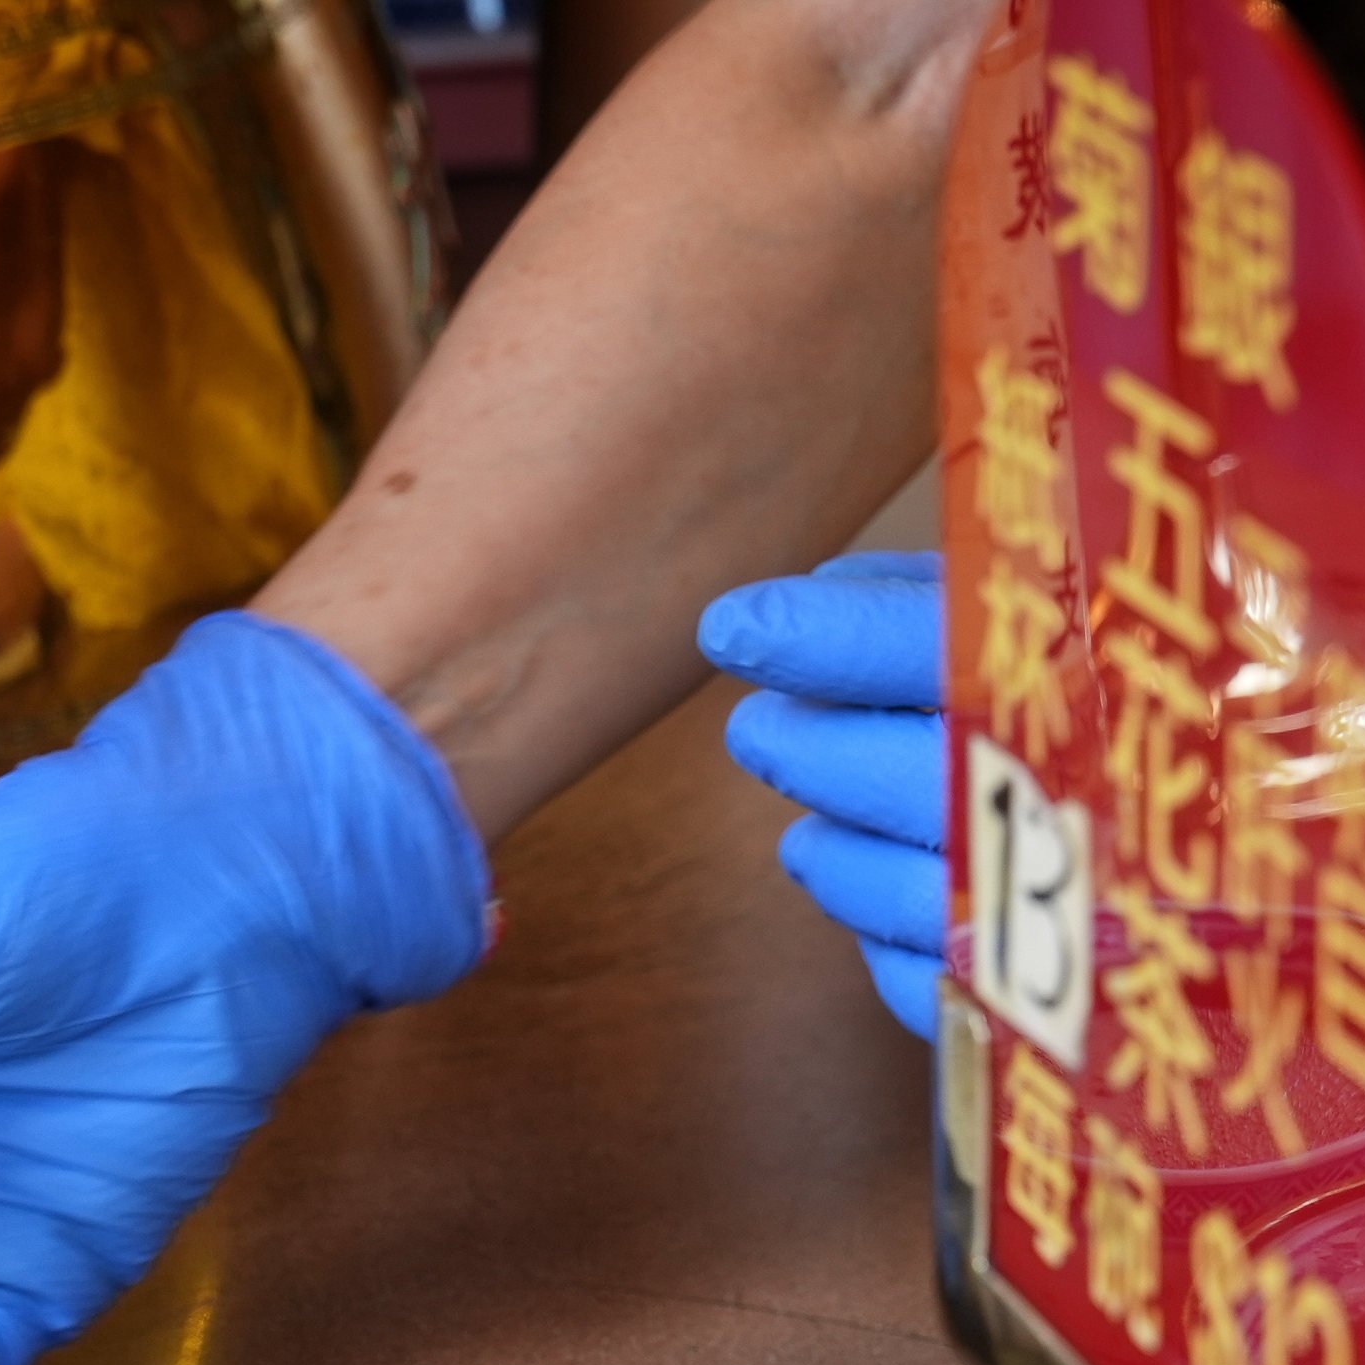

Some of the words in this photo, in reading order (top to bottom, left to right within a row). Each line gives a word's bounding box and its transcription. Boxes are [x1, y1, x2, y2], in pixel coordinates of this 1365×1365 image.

[989, 780, 1073, 1008] 13
[1101, 366, 1221, 1160] 五花茶
[1003, 1045, 1163, 1352] 每碗
